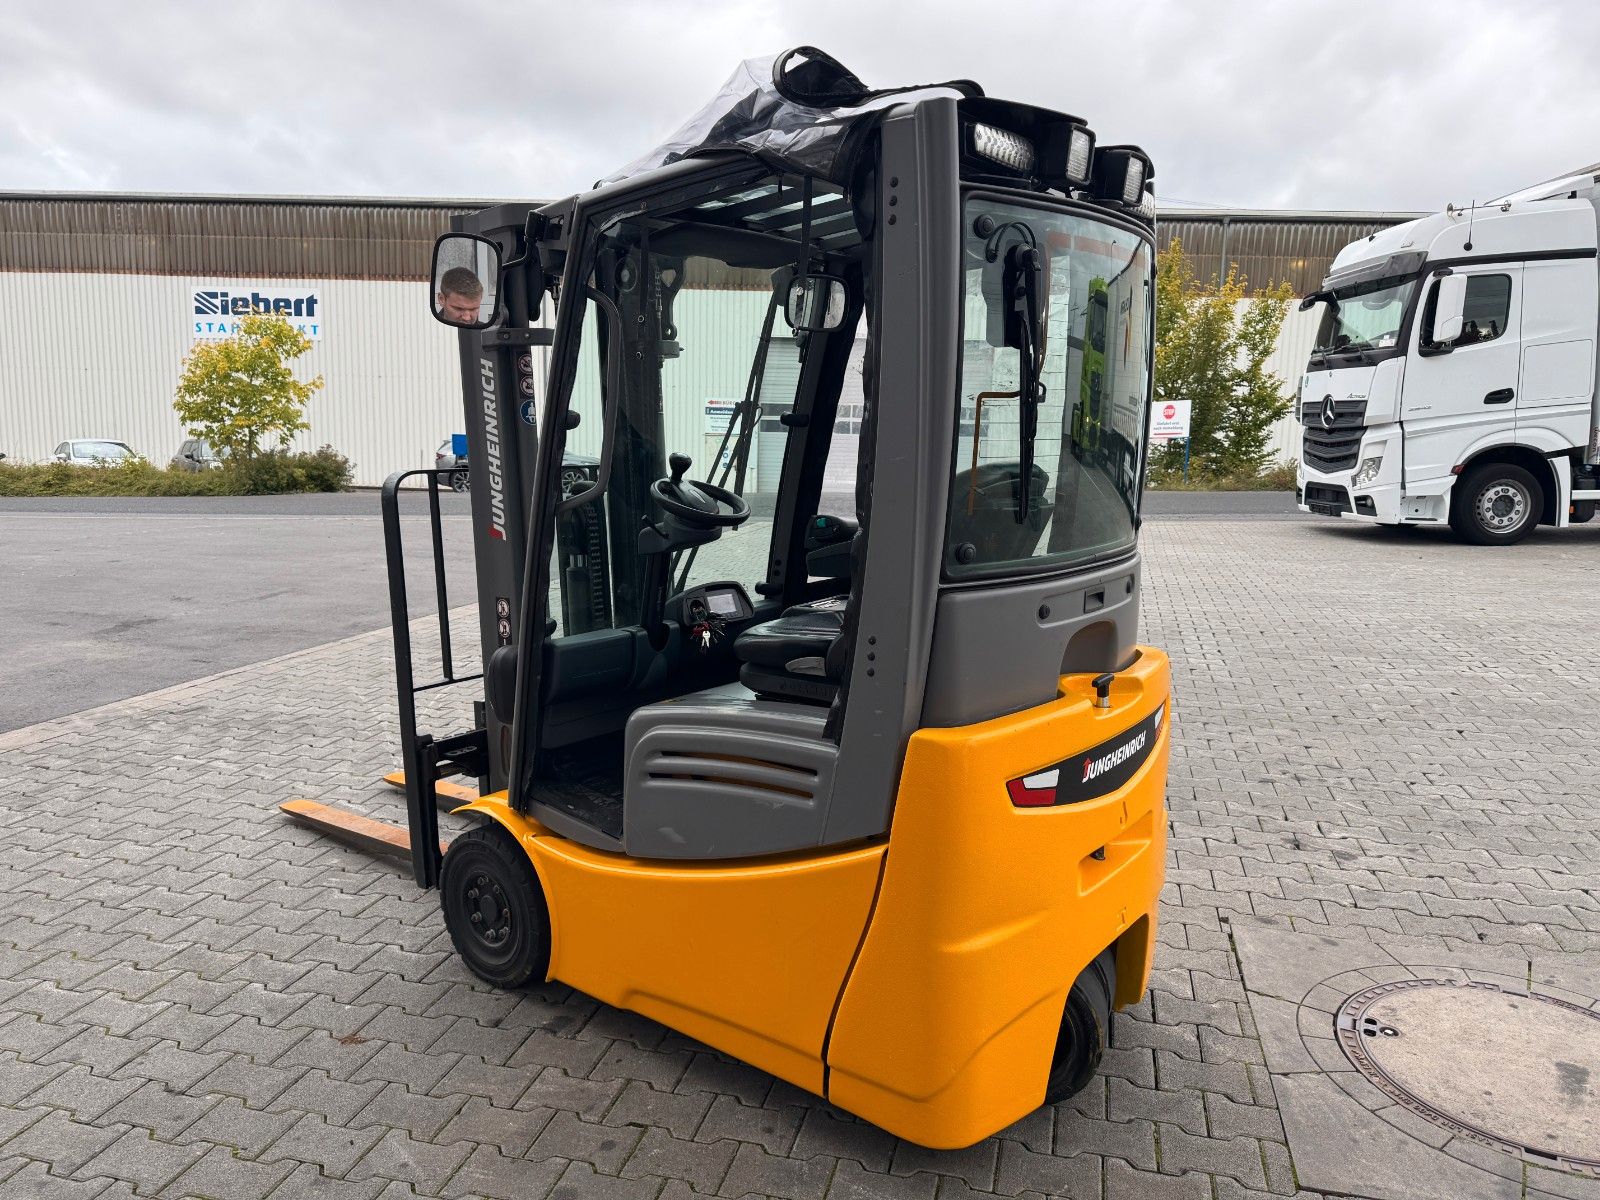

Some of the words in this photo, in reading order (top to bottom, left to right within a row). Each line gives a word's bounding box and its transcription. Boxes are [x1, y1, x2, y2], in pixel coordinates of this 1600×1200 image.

[194, 291, 318, 317] Siebert
[1163, 408, 1175, 416] STOP
[480, 358, 507, 541] JUNGHEINRICH
[1081, 730, 1147, 784] JUNGHEINRICH
